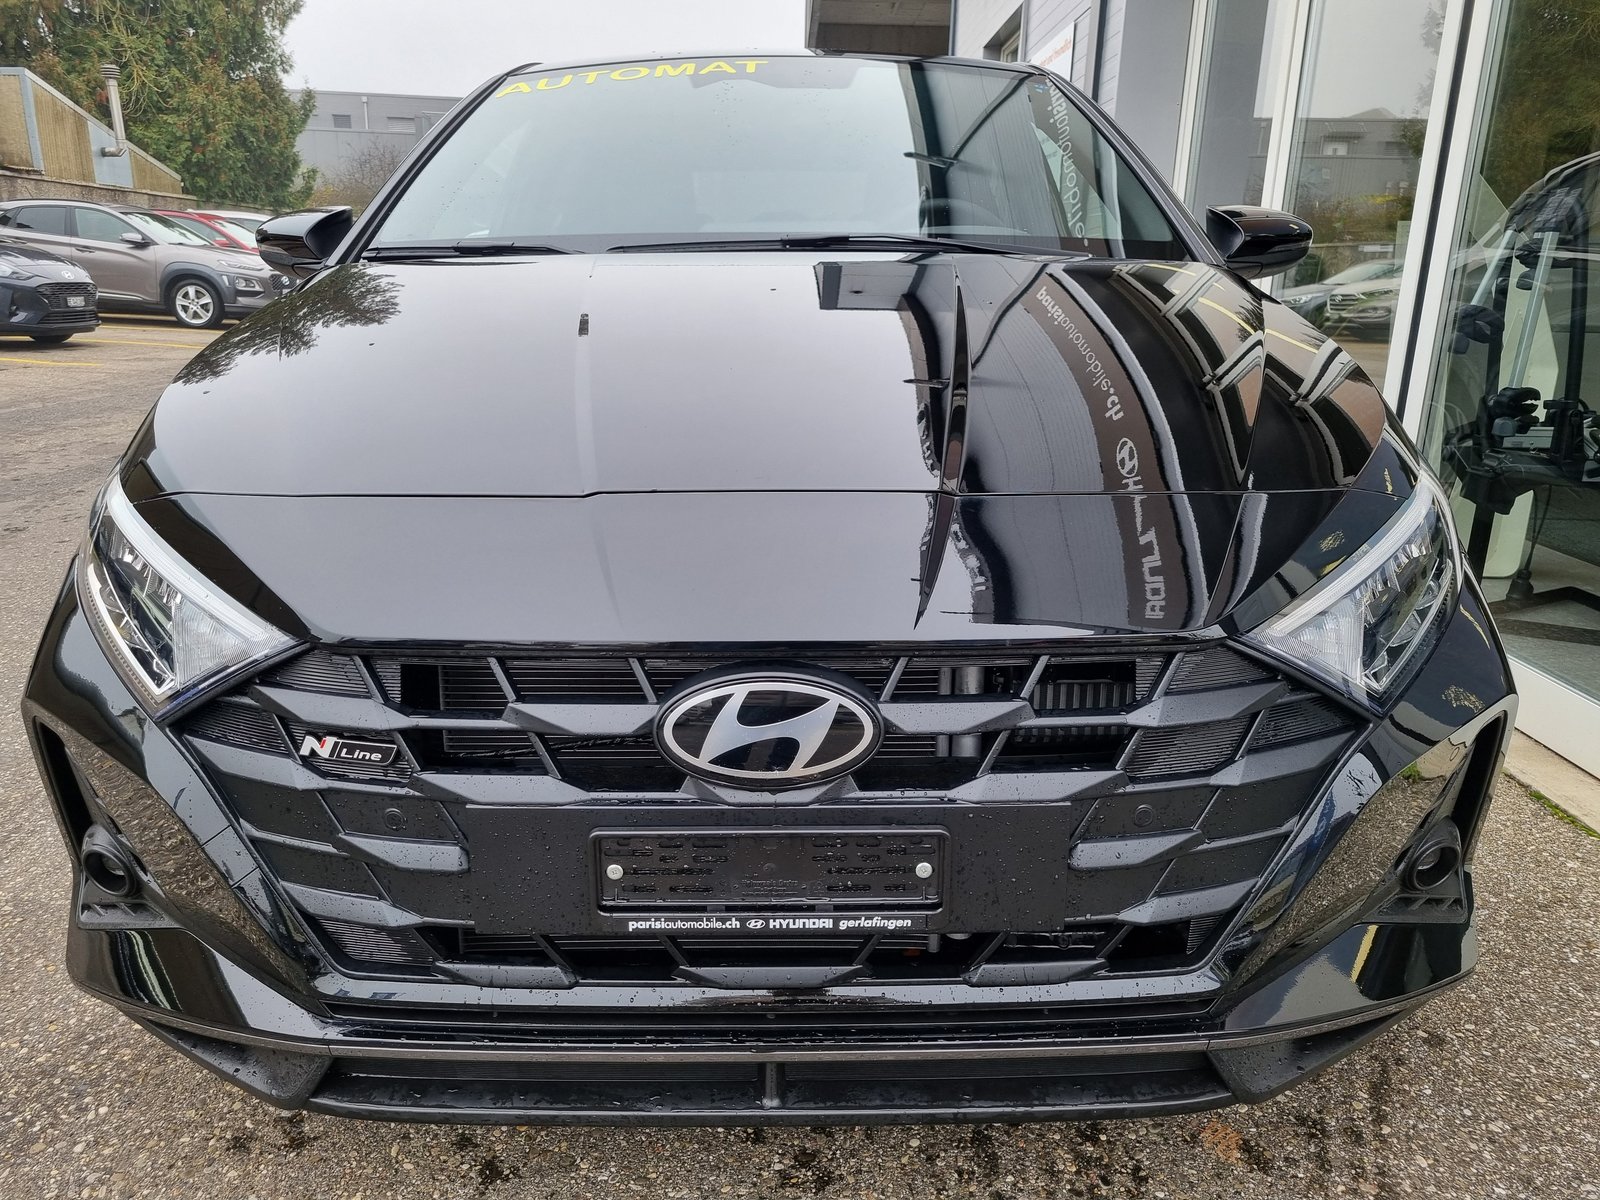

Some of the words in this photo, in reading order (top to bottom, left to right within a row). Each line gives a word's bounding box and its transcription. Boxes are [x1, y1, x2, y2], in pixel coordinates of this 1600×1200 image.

[495, 60, 768, 97] AUTOMAT
[300, 735, 337, 758] N
[340, 748, 382, 761] Line
[628, 917, 741, 932] parisiautomobile.ch
[769, 918, 833, 929] HYUNDAI
[838, 916, 912, 930] gerlafingen
